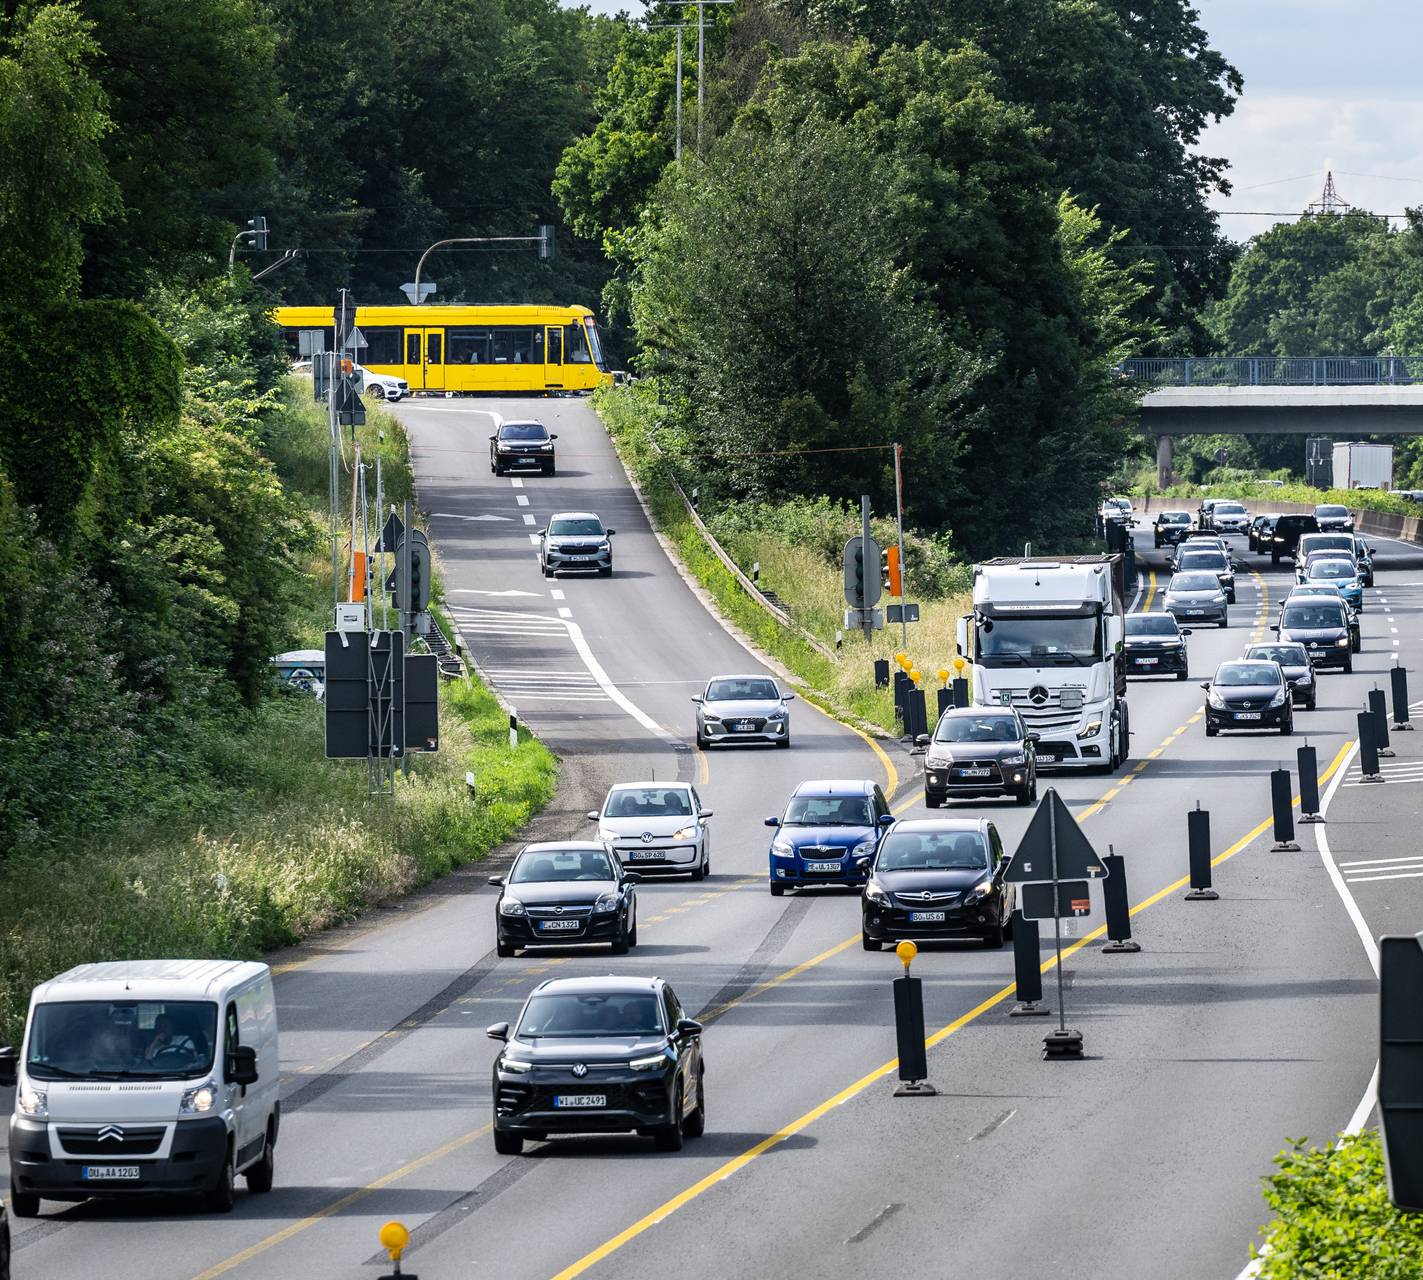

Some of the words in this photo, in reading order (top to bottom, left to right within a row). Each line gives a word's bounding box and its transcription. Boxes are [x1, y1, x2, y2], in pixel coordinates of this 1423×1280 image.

[559, 1096, 568, 1106] WI
[586, 1095, 605, 1105] 2491
[105, 1168, 116, 1177] AA
[117, 1168, 139, 1178] 1203
